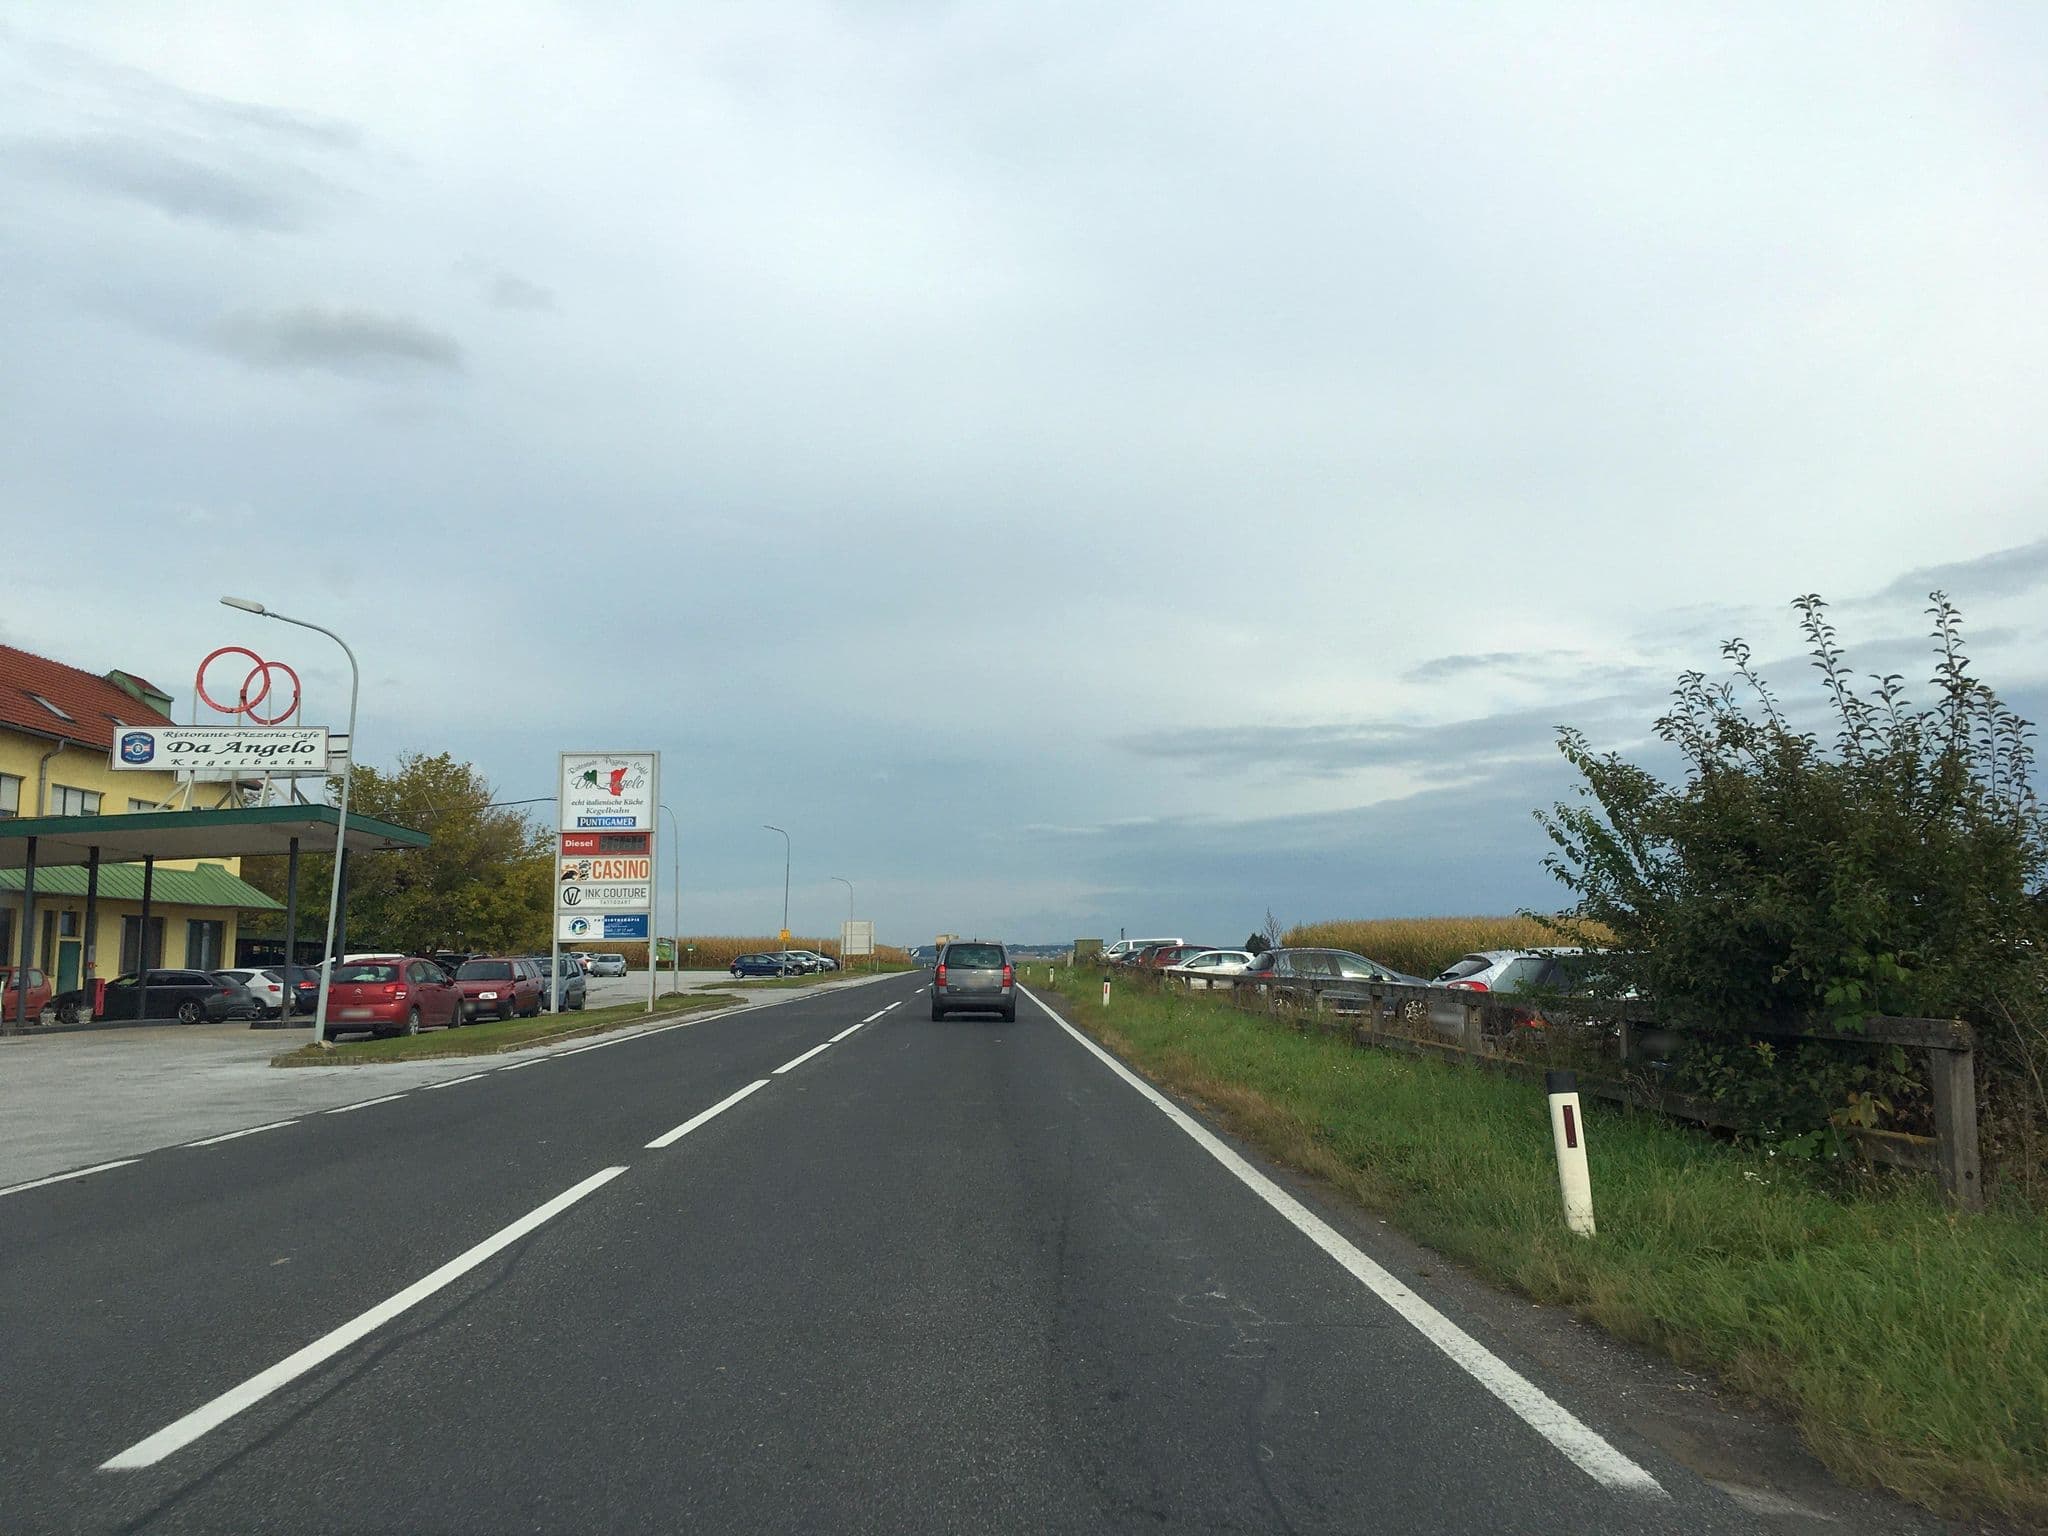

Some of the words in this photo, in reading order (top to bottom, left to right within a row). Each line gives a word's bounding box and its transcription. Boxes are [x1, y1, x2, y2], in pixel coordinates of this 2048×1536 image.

[166, 741, 212, 753] Da
[214, 740, 315, 757] Angelo
[170, 758, 312, 766] Kegelbahn
[586, 807, 630, 815] Kegelbahn
[580, 817, 634, 826] PUNTIGAMER
[592, 860, 649, 879] CASINO
[585, 888, 601, 897] INK
[603, 888, 647, 897] COUTURE
